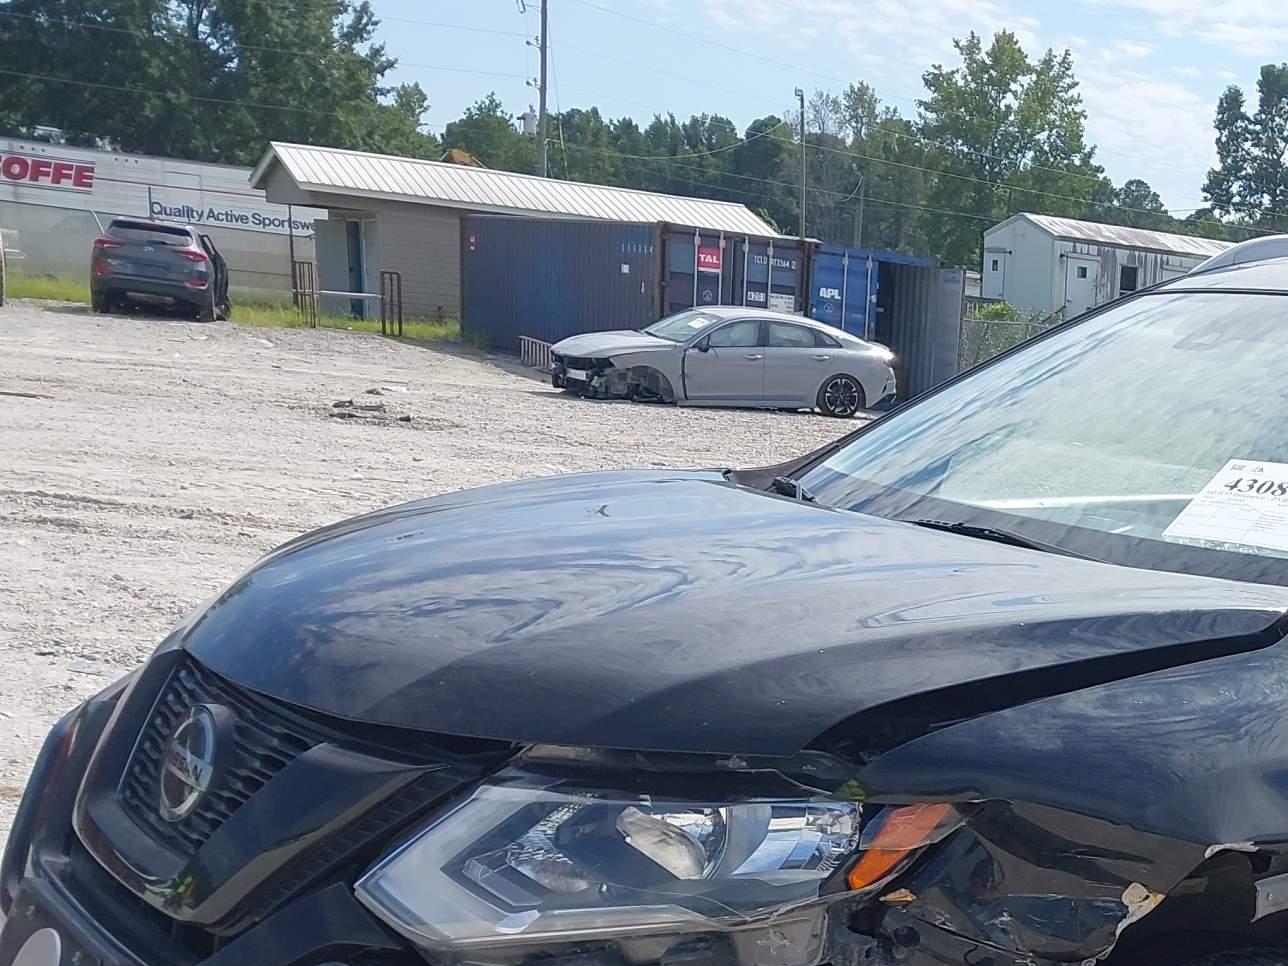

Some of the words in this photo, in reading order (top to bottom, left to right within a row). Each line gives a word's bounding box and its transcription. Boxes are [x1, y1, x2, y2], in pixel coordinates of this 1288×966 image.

[0, 156, 95, 188] OFFE
[151, 201, 204, 222] Quality
[206, 207, 249, 224] Active
[698, 253, 720, 264] TAL
[819, 287, 841, 299] APL
